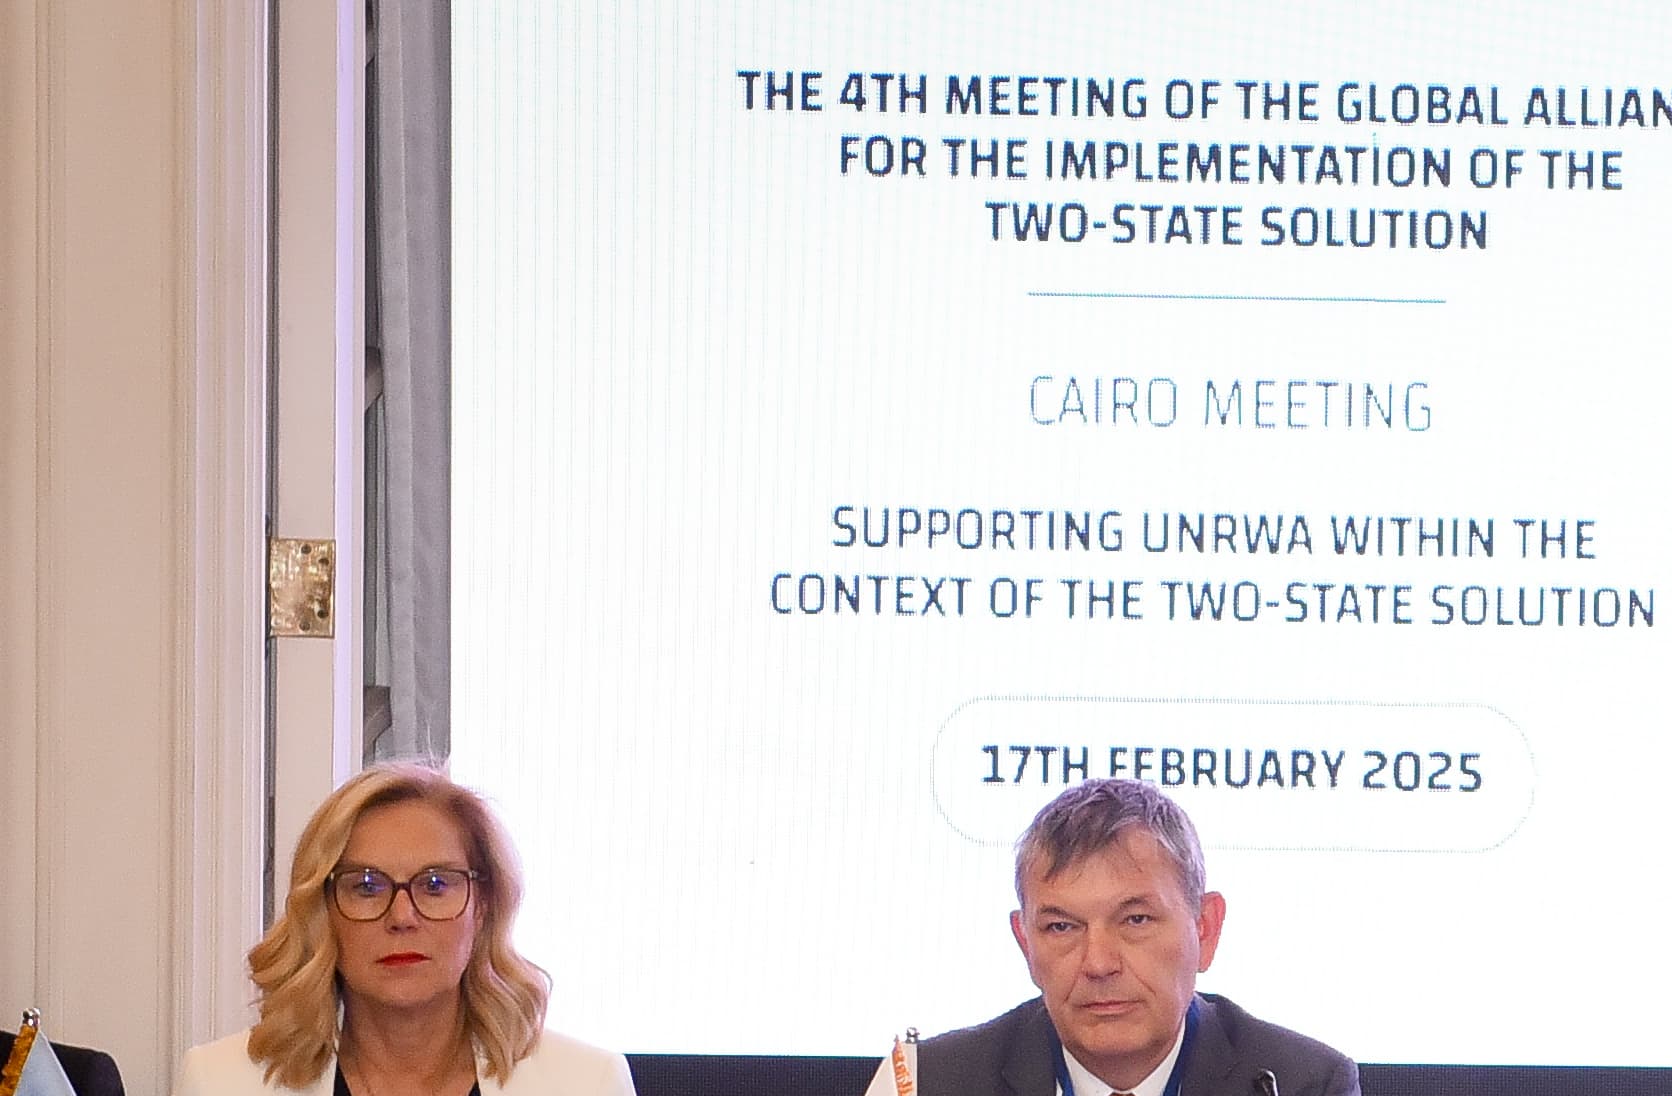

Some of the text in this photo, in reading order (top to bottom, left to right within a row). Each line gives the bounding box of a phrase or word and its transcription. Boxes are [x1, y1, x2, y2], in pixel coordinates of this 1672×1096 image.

[736, 71, 822, 111] THE
[837, 73, 927, 114] 4TH
[946, 75, 1146, 118] MEETING
[1166, 79, 1221, 119] OF
[1235, 80, 1319, 121] THE
[1338, 82, 1508, 126] GLOBAL
[841, 136, 1622, 190] FOR THE IMPLEMENTATION OF THE
[985, 202, 1486, 249] TWO-STATE SOLUTION
[1030, 375, 1430, 432] CAIRO MEETING
[833, 506, 1595, 559] SUPPORTING UNRWA WITHIN THE
[772, 573, 1653, 627] CONTEXT OF THE TWO-STATE SOLUTION
[982, 746, 1483, 793] 17TH FEBRUARY 2025
